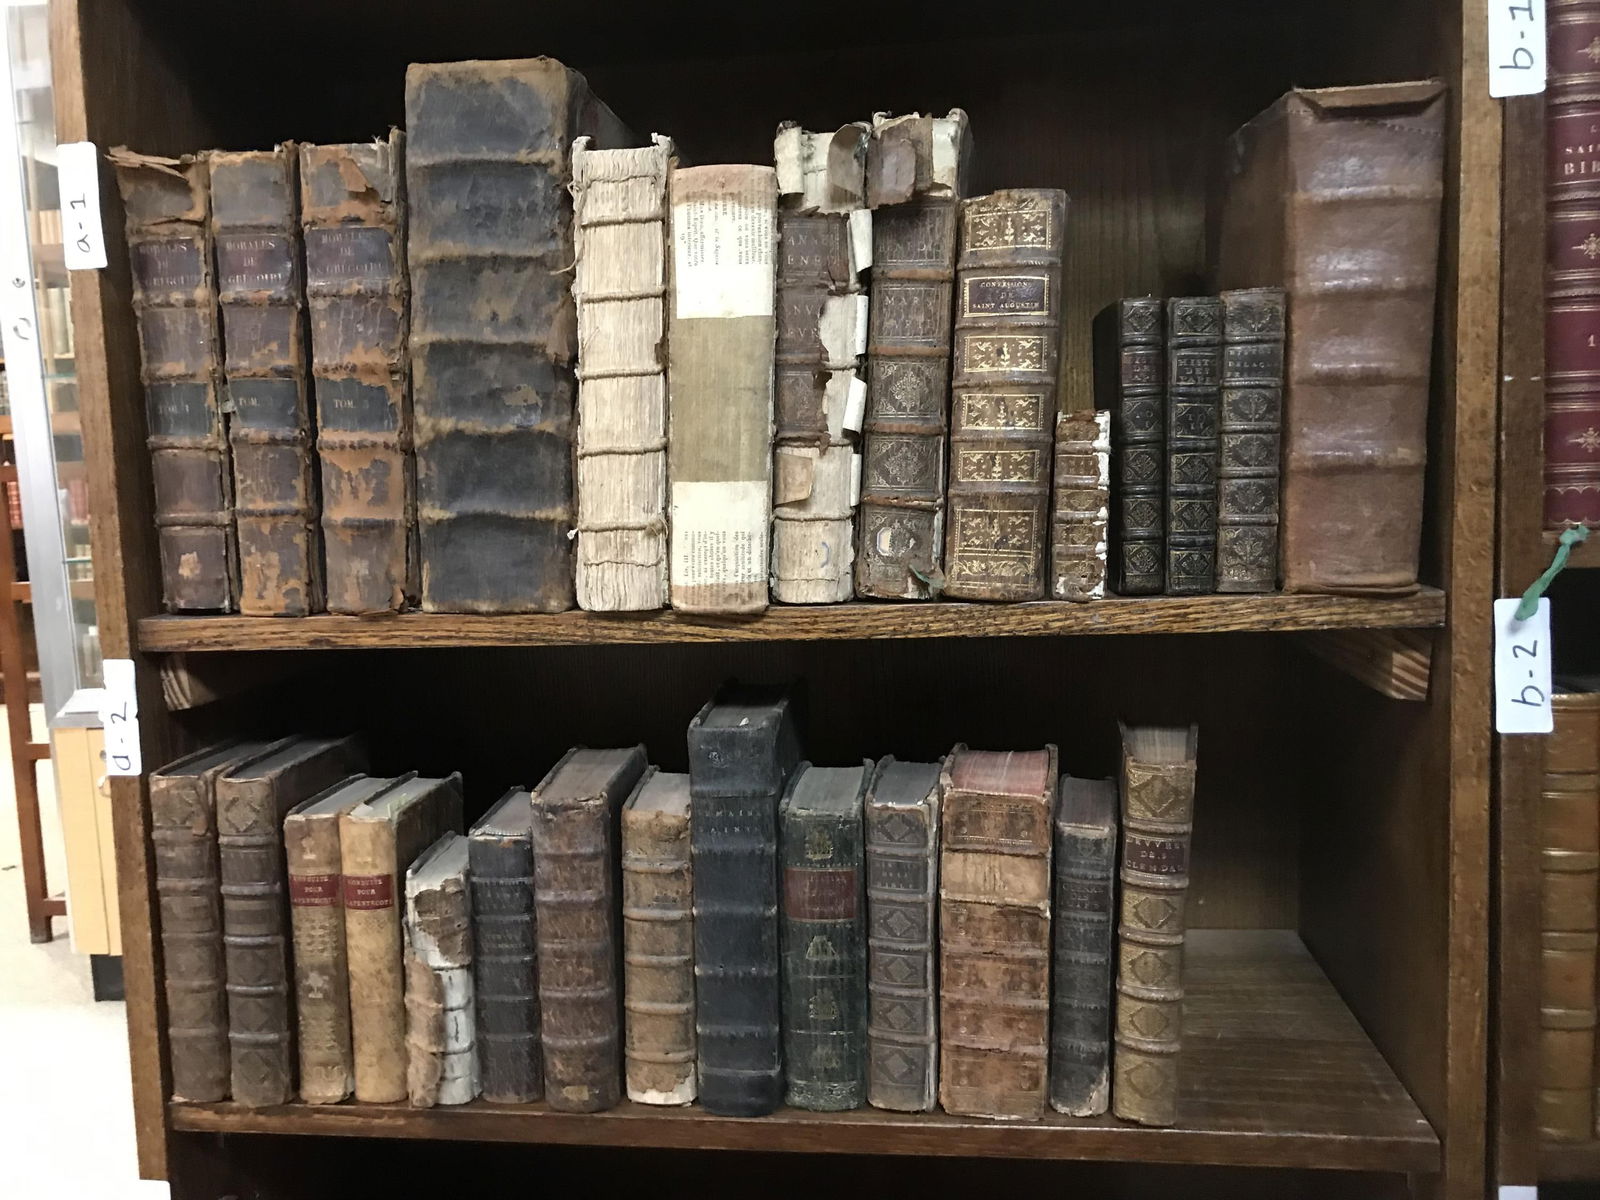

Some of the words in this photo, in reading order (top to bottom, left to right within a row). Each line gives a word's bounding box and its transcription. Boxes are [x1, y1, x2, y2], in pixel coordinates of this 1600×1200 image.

[1499, 0, 1534, 70] b-1
[70, 193, 90, 254] a-1
[1511, 640, 1545, 708] b-2
[111, 701, 131, 771] a-2
